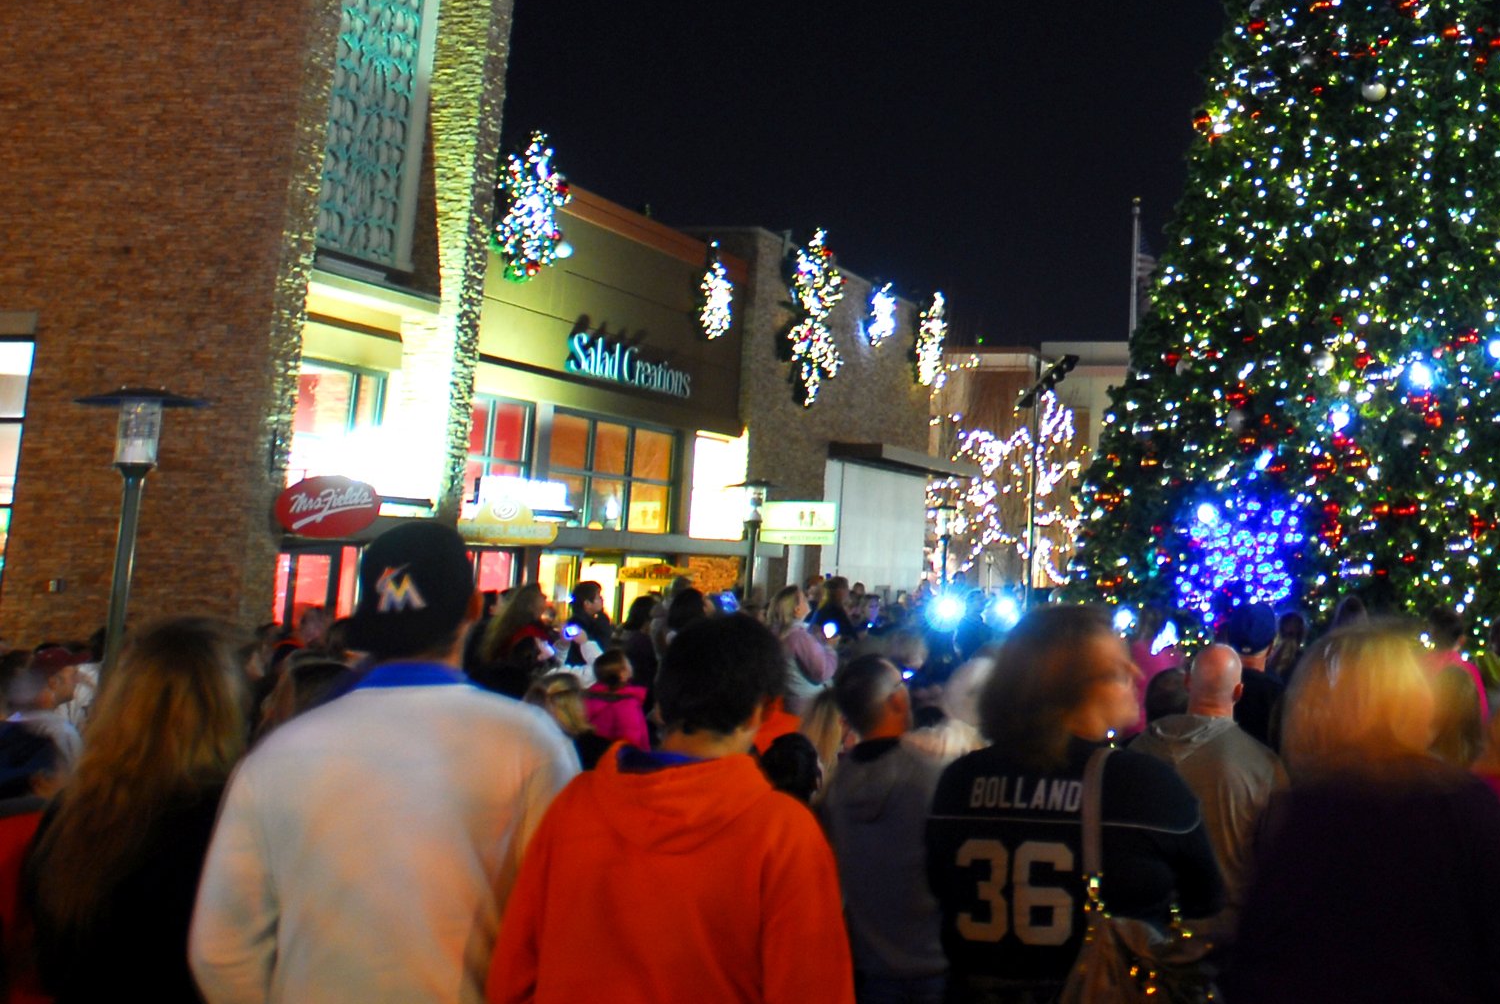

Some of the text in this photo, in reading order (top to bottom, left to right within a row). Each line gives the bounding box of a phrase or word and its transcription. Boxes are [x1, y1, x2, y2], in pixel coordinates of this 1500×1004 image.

[568, 332, 691, 399] Salad Creations
[316, 486, 373, 523] Fields
[969, 776, 1083, 813] BOLLAND
[955, 838, 1075, 946] 36
